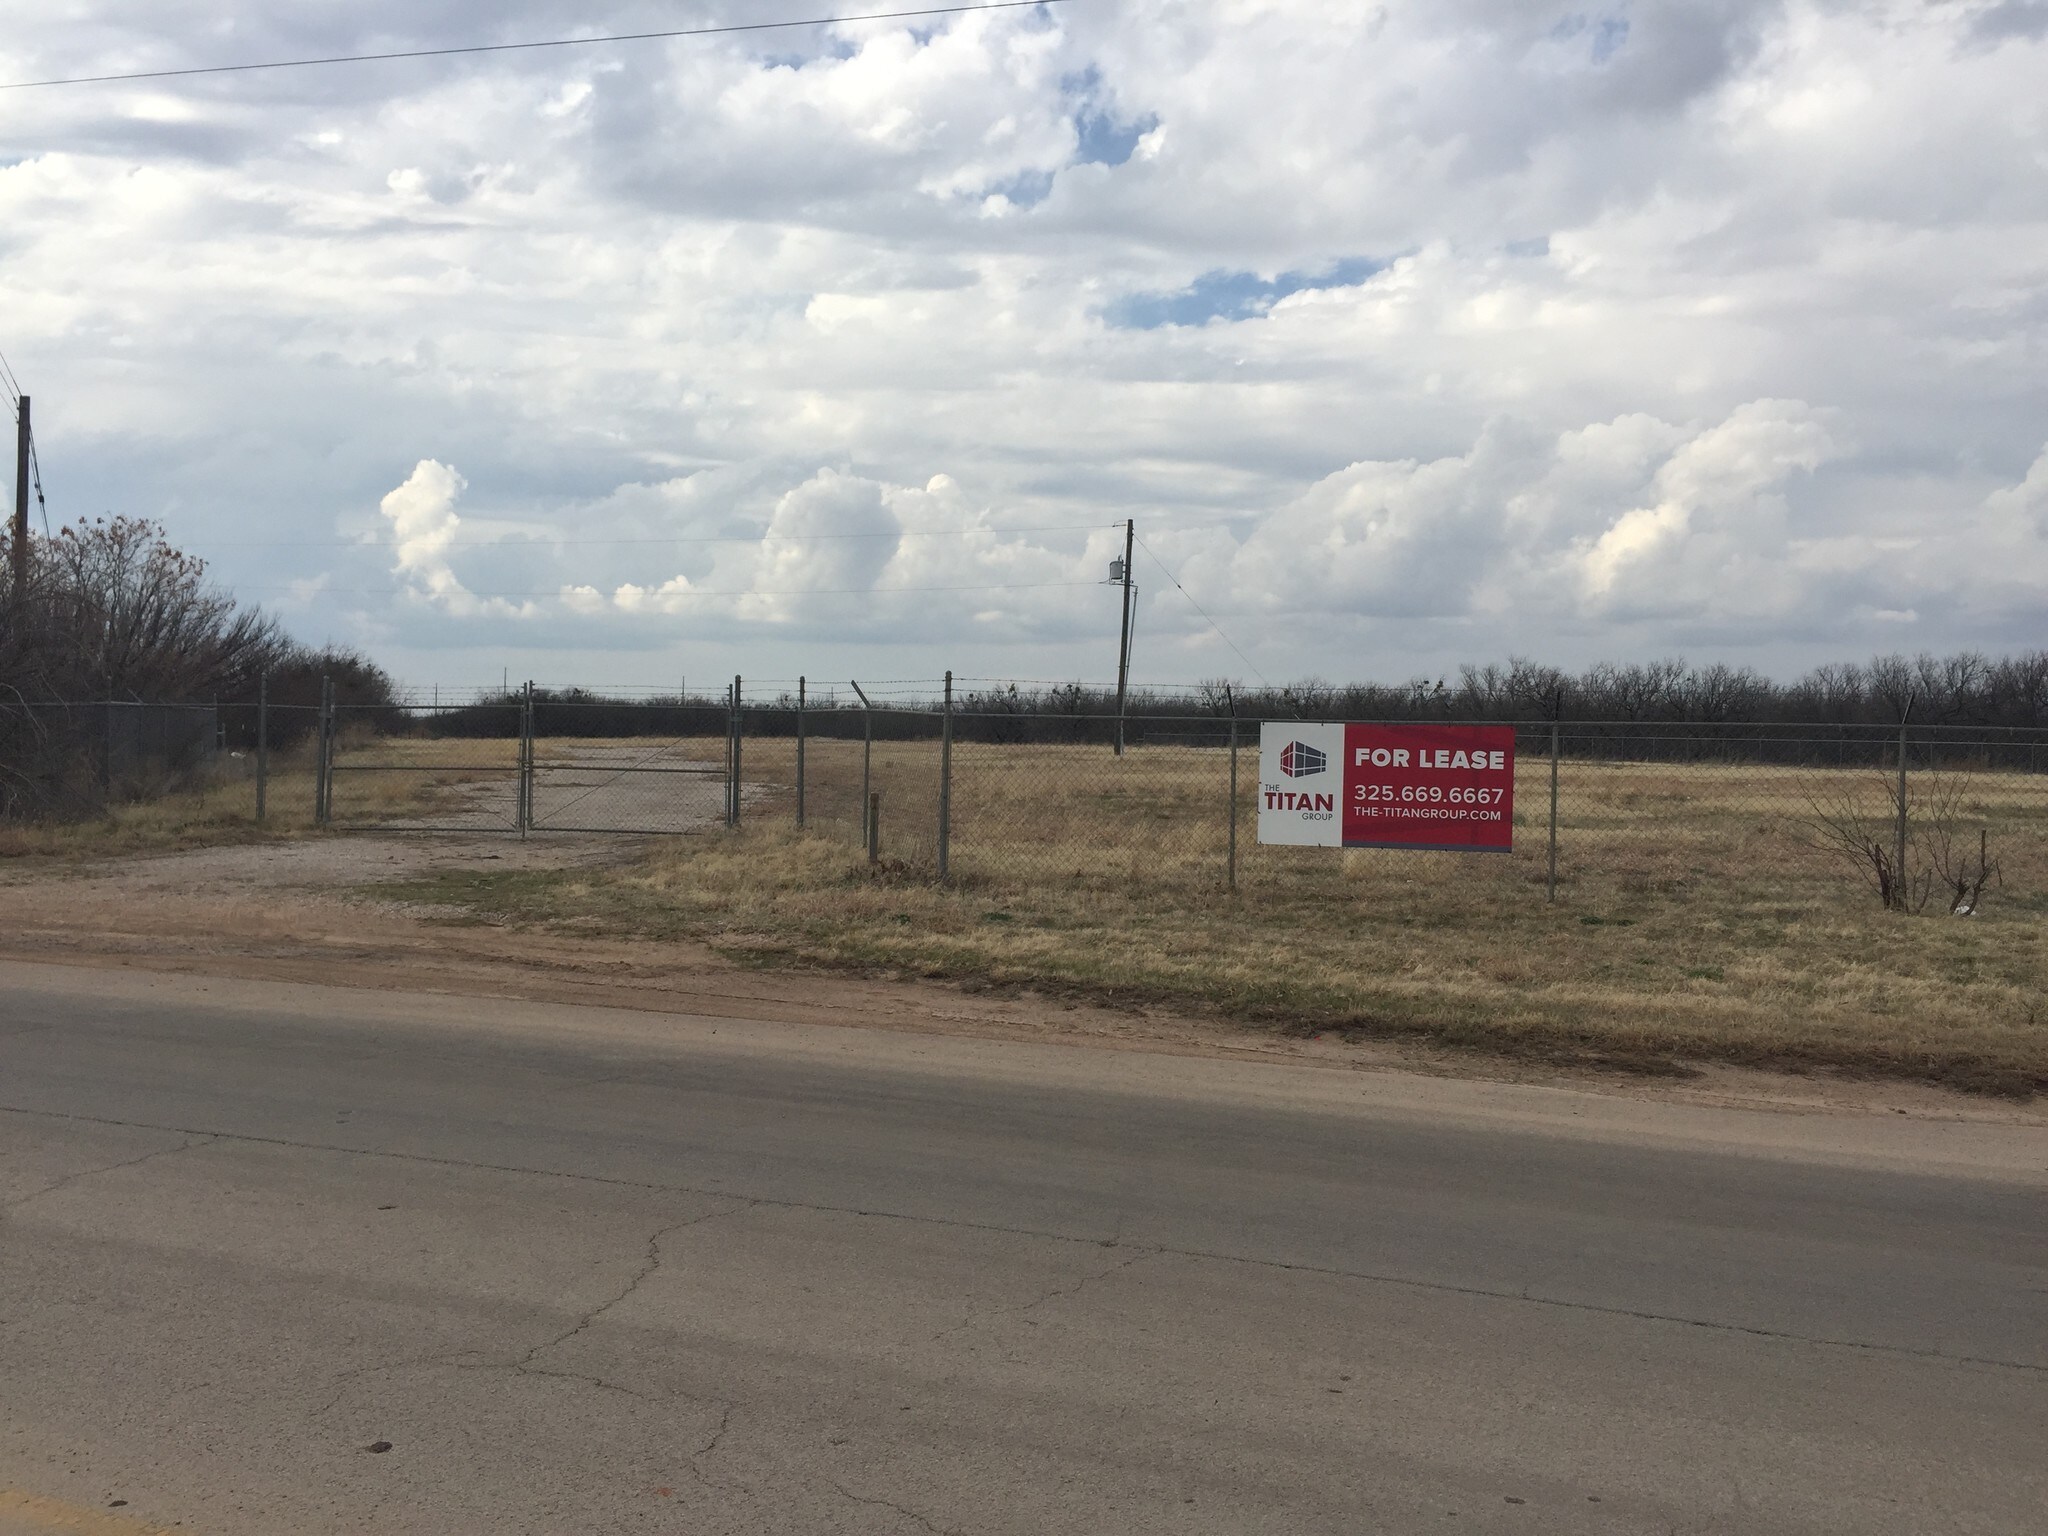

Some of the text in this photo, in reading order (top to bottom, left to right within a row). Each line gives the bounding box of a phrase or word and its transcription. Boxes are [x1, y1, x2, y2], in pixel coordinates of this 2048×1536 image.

[1355, 748, 1505, 770] FOR LEASE
[1264, 784, 1280, 792] THE
[1354, 784, 1504, 804] 325.669.6667
[1264, 792, 1334, 812] TITAN
[1301, 812, 1333, 821] GROUP
[1354, 806, 1501, 821] THE-TITANGROUP.COM
